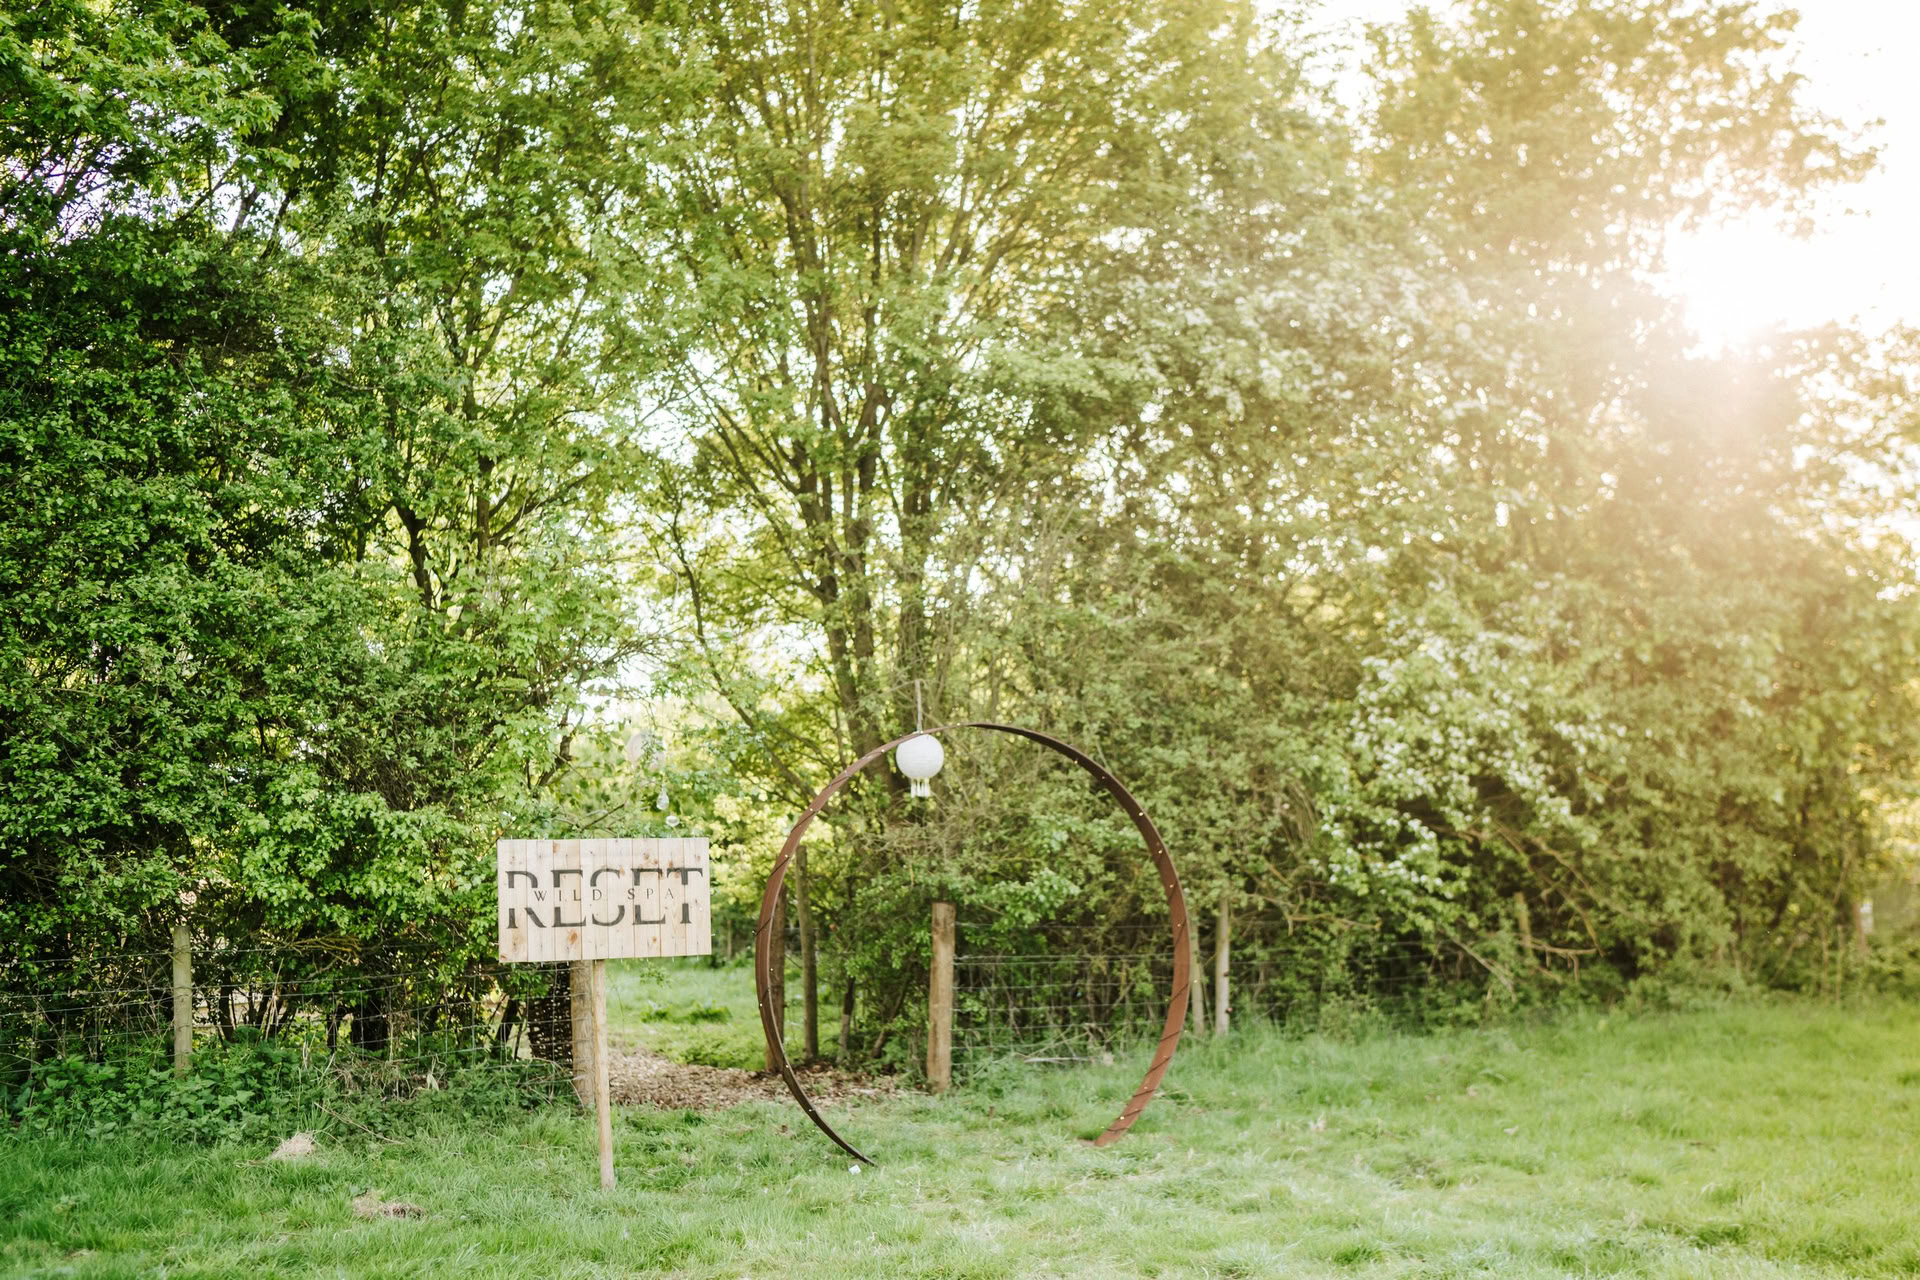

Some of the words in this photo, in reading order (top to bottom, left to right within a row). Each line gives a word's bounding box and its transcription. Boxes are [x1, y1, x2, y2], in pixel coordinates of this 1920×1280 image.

[505, 867, 703, 929] RESET
[534, 888, 602, 901] WILD
[627, 888, 674, 900] SPA
